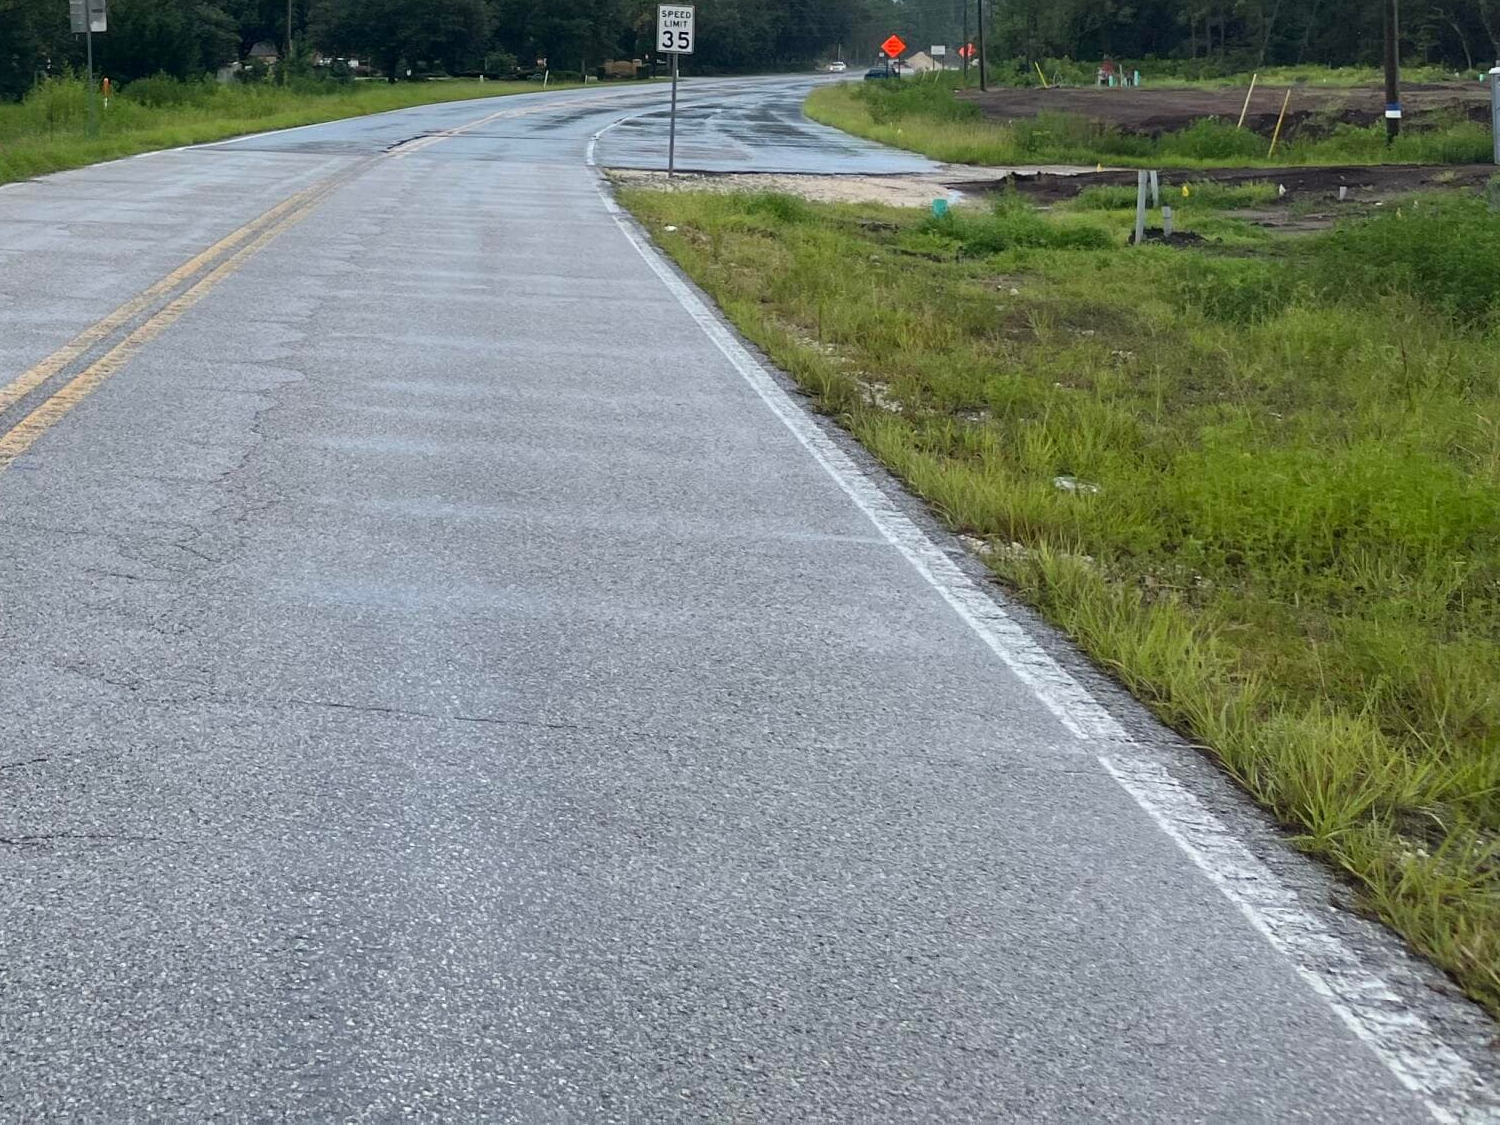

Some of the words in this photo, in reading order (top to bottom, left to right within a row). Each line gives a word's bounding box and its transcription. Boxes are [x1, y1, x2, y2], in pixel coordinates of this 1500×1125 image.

[661, 10, 692, 19] SPEED
[664, 20, 688, 28] LIMIT
[662, 30, 690, 50] 35
